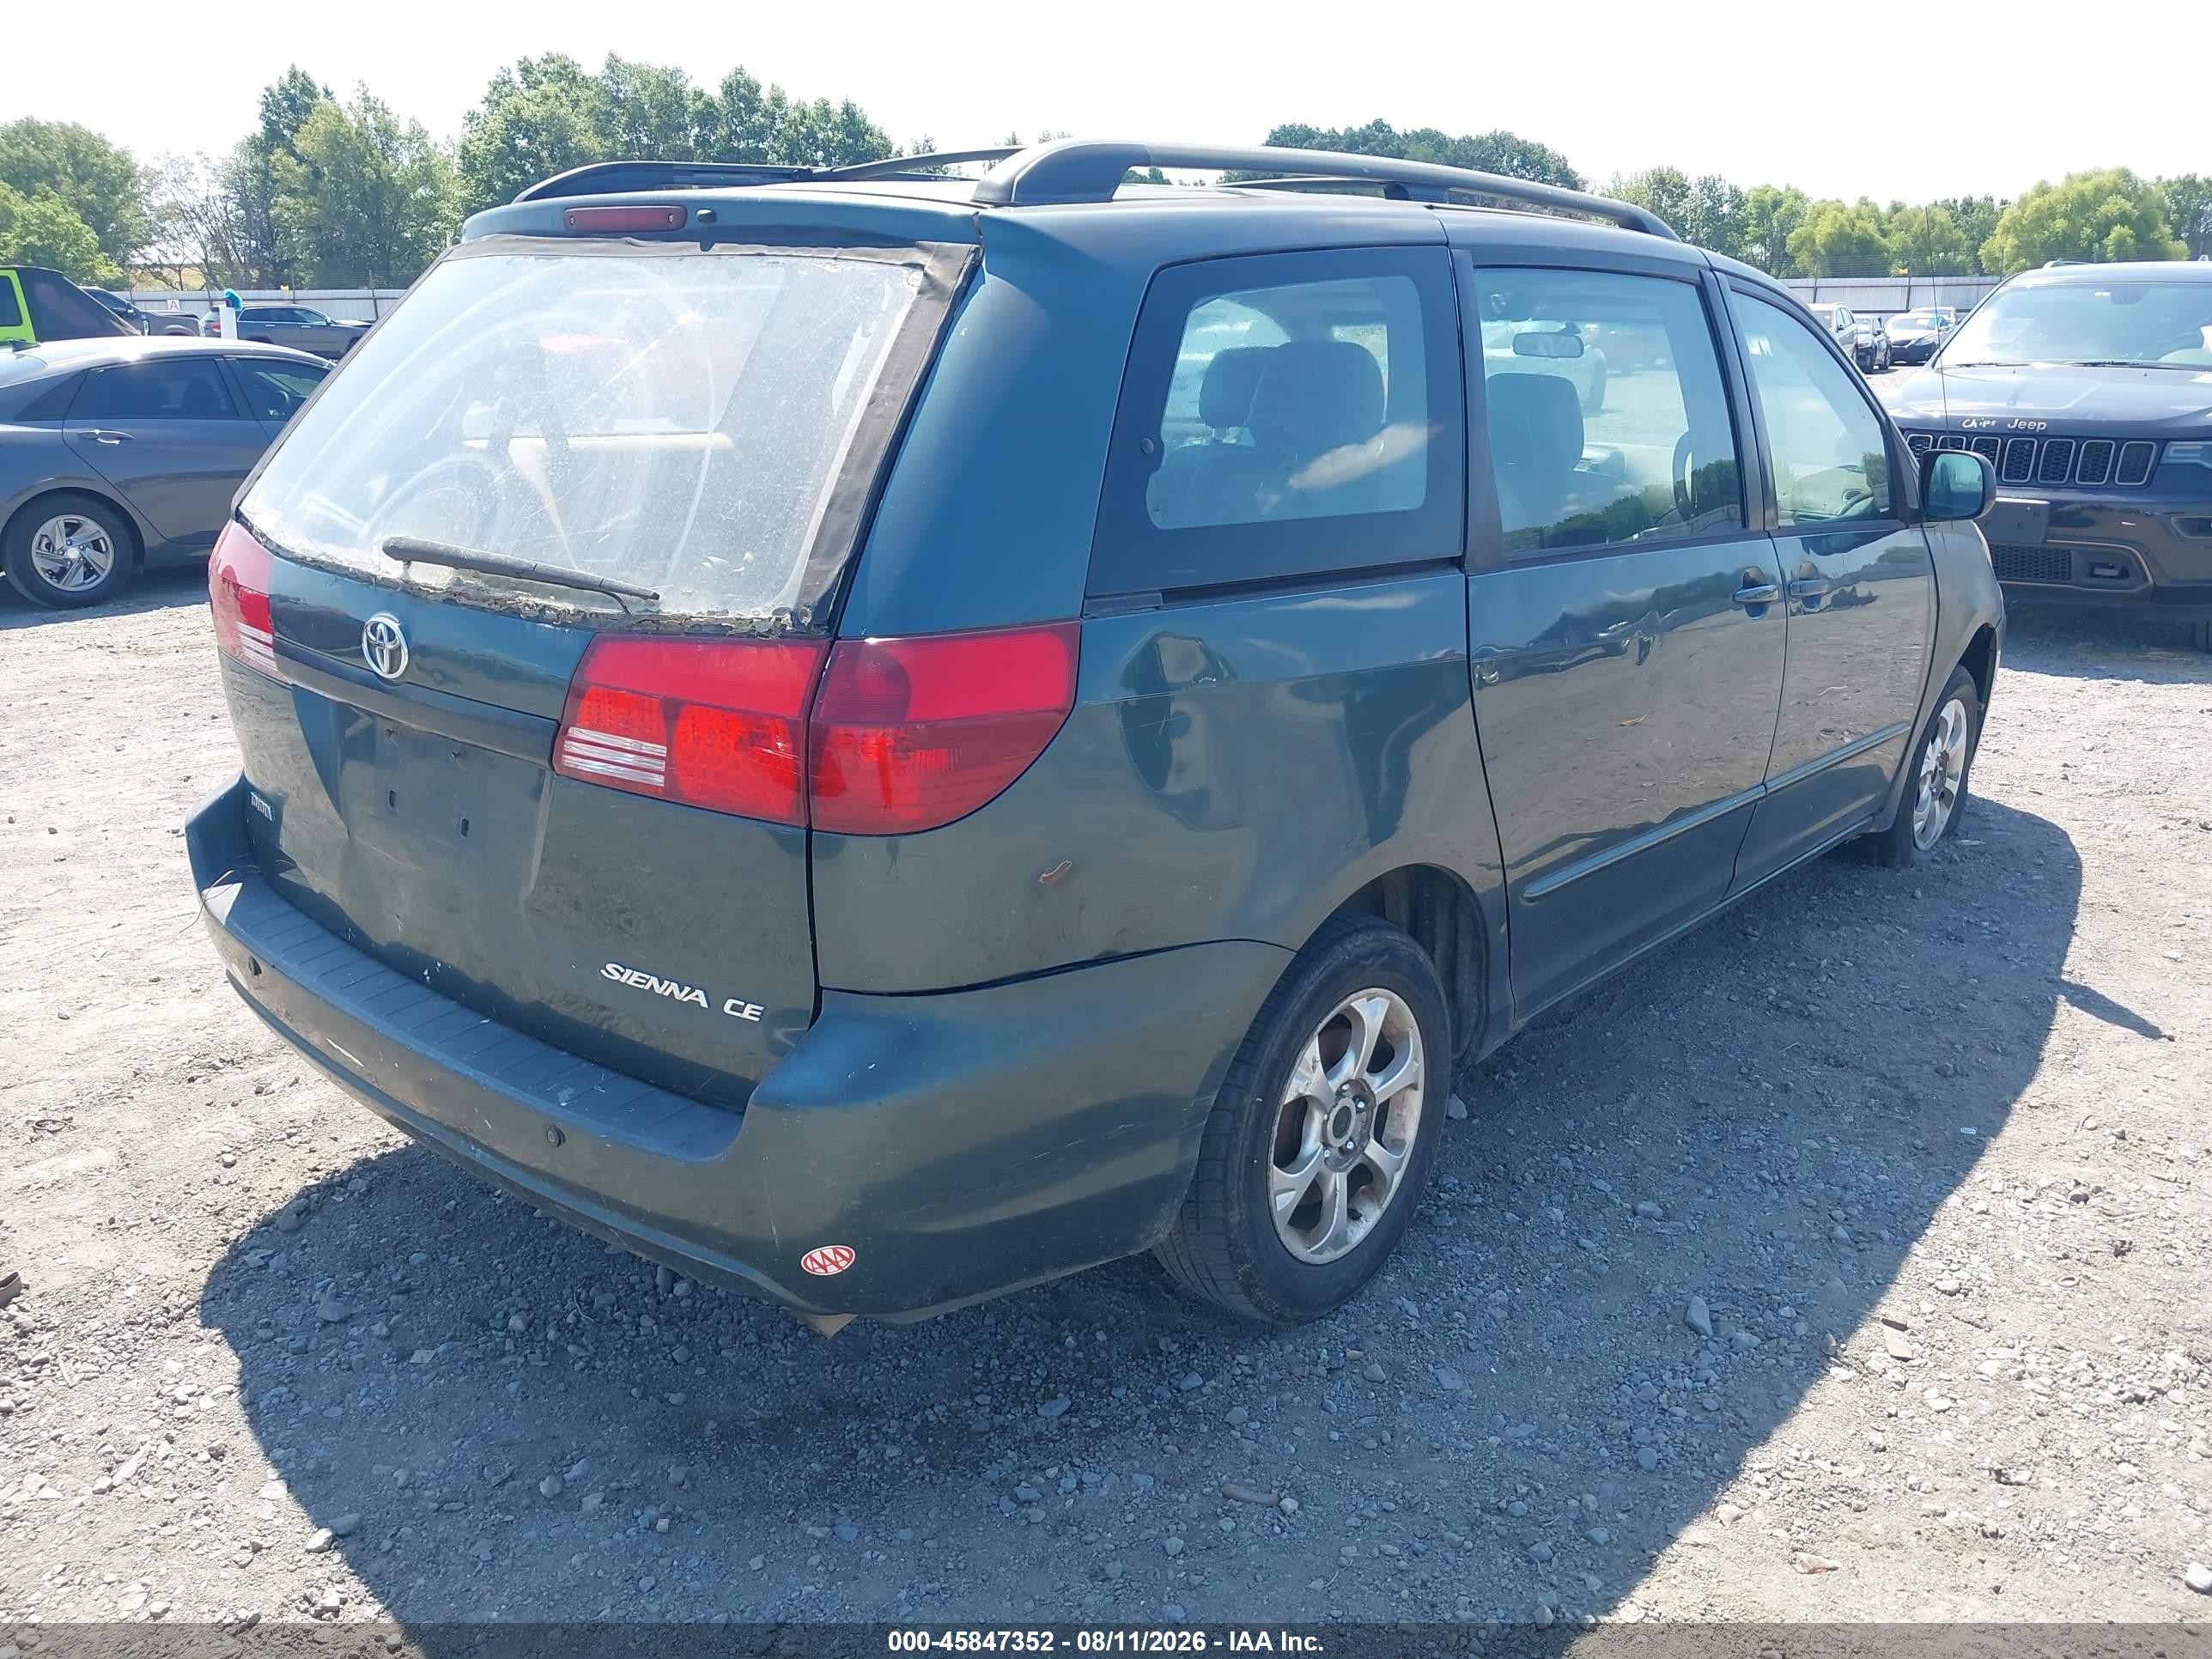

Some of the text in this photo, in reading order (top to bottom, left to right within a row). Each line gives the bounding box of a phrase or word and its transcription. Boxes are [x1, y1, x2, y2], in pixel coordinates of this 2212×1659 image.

[170, 301, 179, 311] A
[2007, 418, 2047, 433] Jeep
[600, 963, 764, 1022] SIENNA CE
[804, 1246, 853, 1273] AAA
